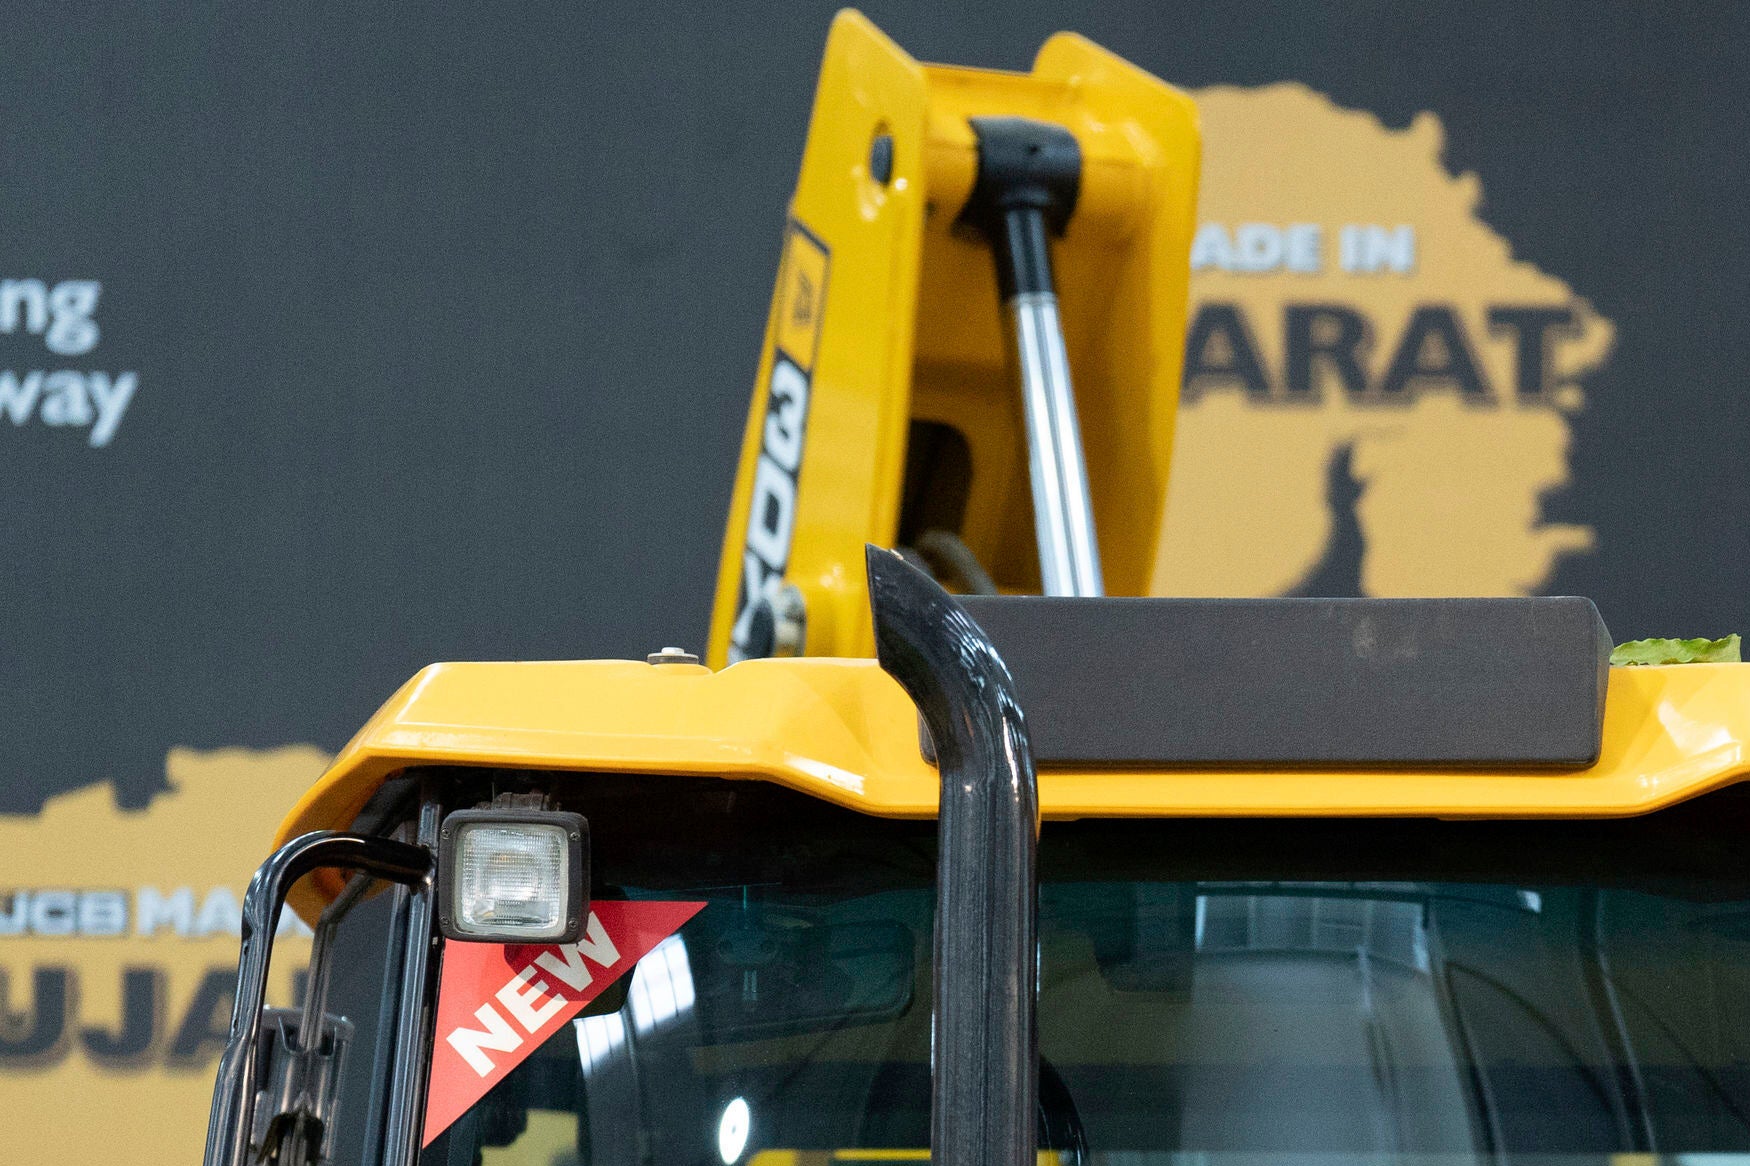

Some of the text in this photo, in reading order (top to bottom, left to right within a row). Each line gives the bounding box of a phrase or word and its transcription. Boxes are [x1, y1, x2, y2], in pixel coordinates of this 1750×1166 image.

[1339, 225, 1413, 272] IN
[1181, 303, 1580, 400] ARAT
[0, 967, 312, 1062] UJA
[446, 911, 621, 1078] NEW
